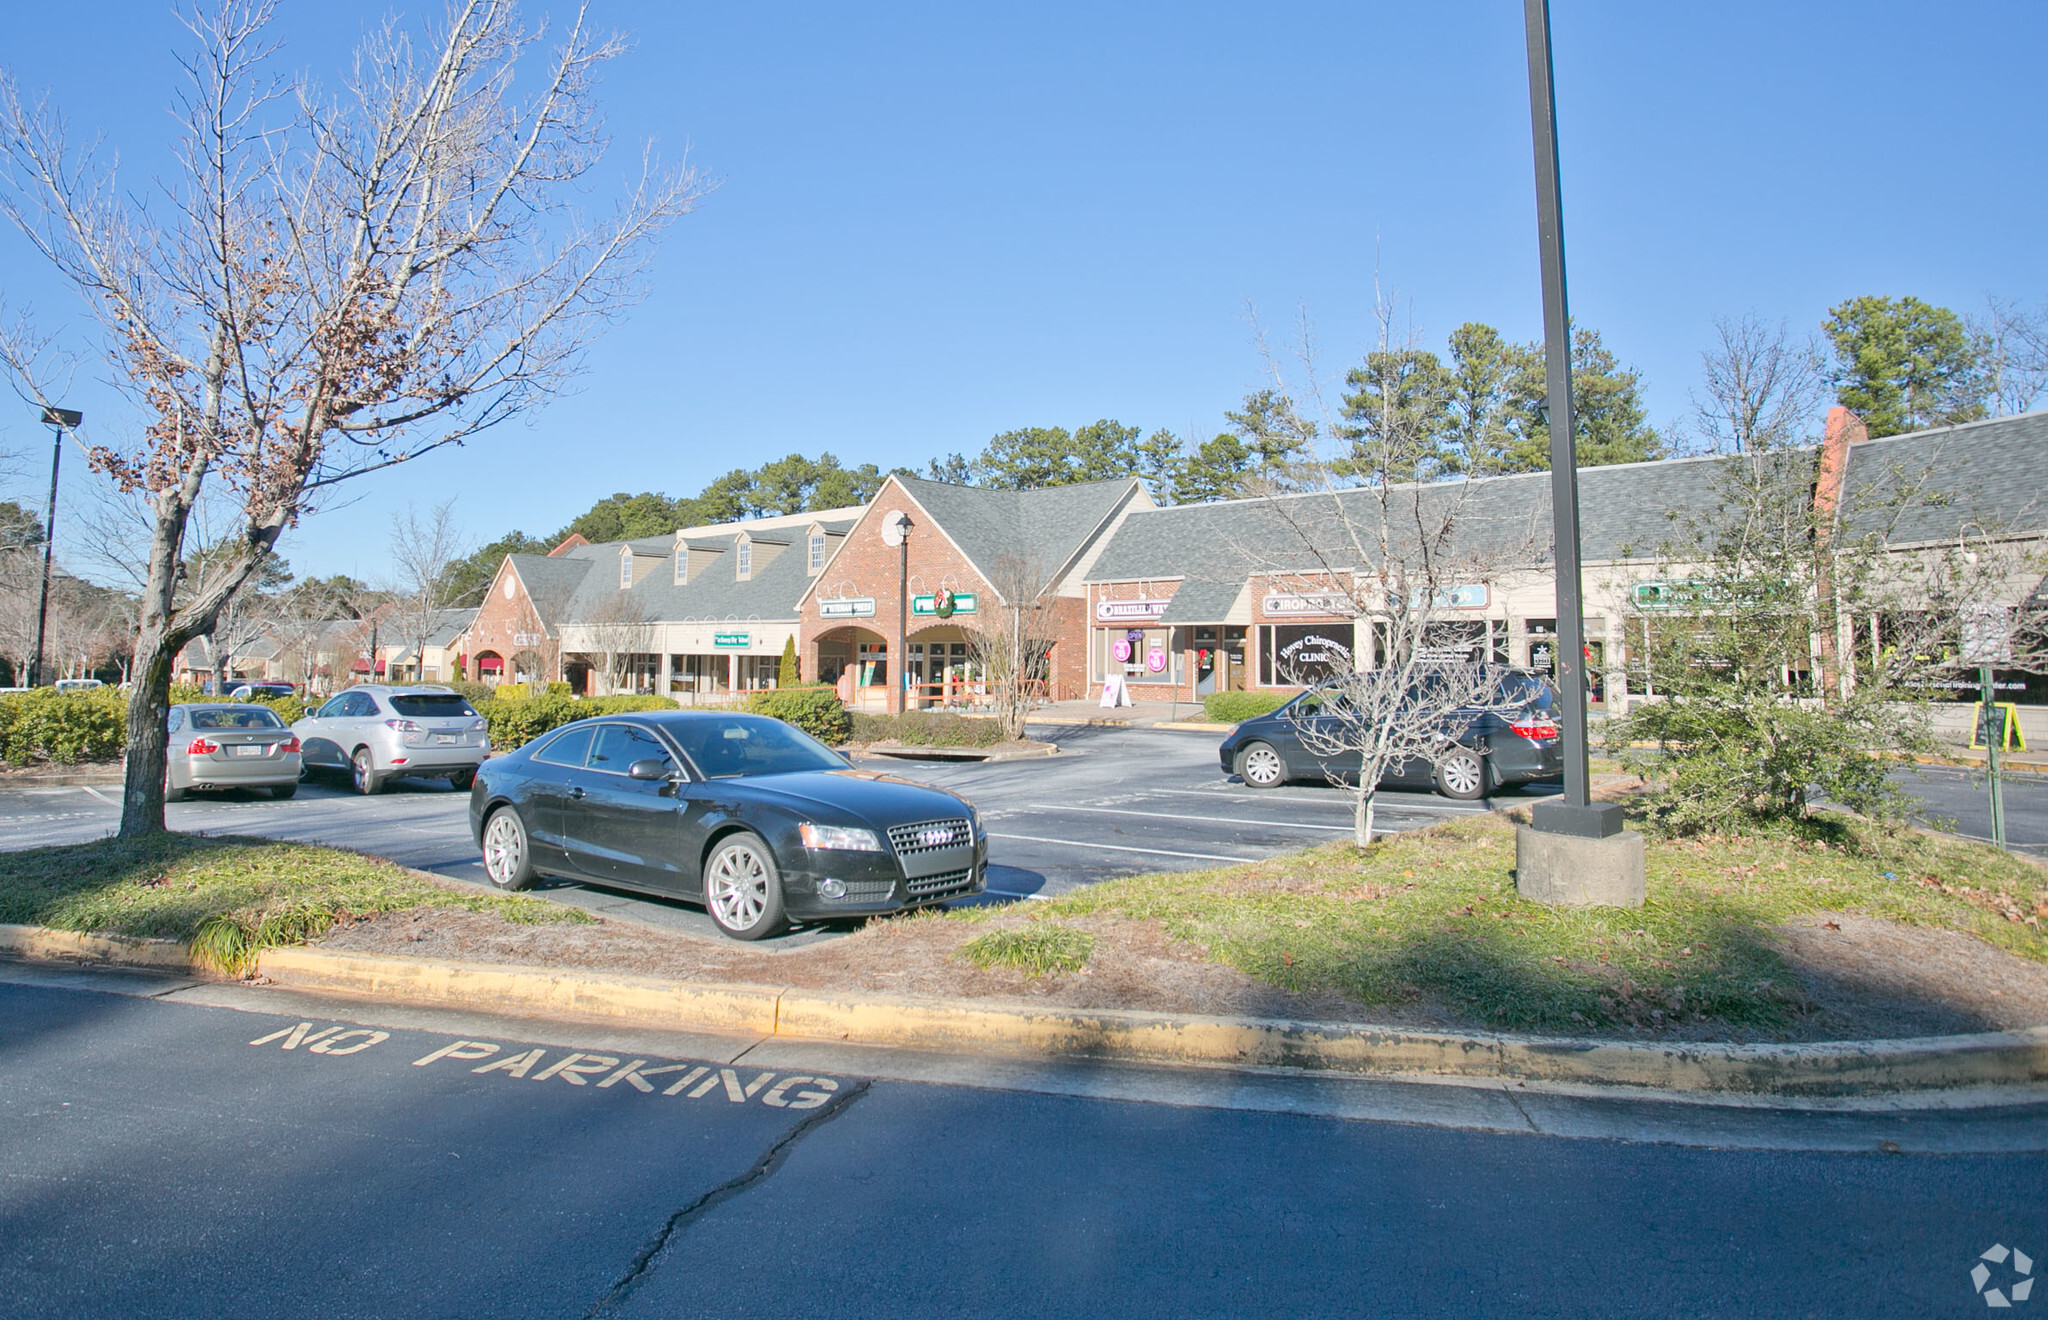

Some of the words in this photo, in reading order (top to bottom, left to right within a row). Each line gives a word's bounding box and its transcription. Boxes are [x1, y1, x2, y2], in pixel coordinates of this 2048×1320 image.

[1280, 640, 1303, 659] Hovey
[1304, 635, 1350, 658] Chiropractic
[1299, 652, 1330, 662] CLINIC
[250, 1022, 389, 1055] NO
[412, 1040, 839, 1109] PARKING
